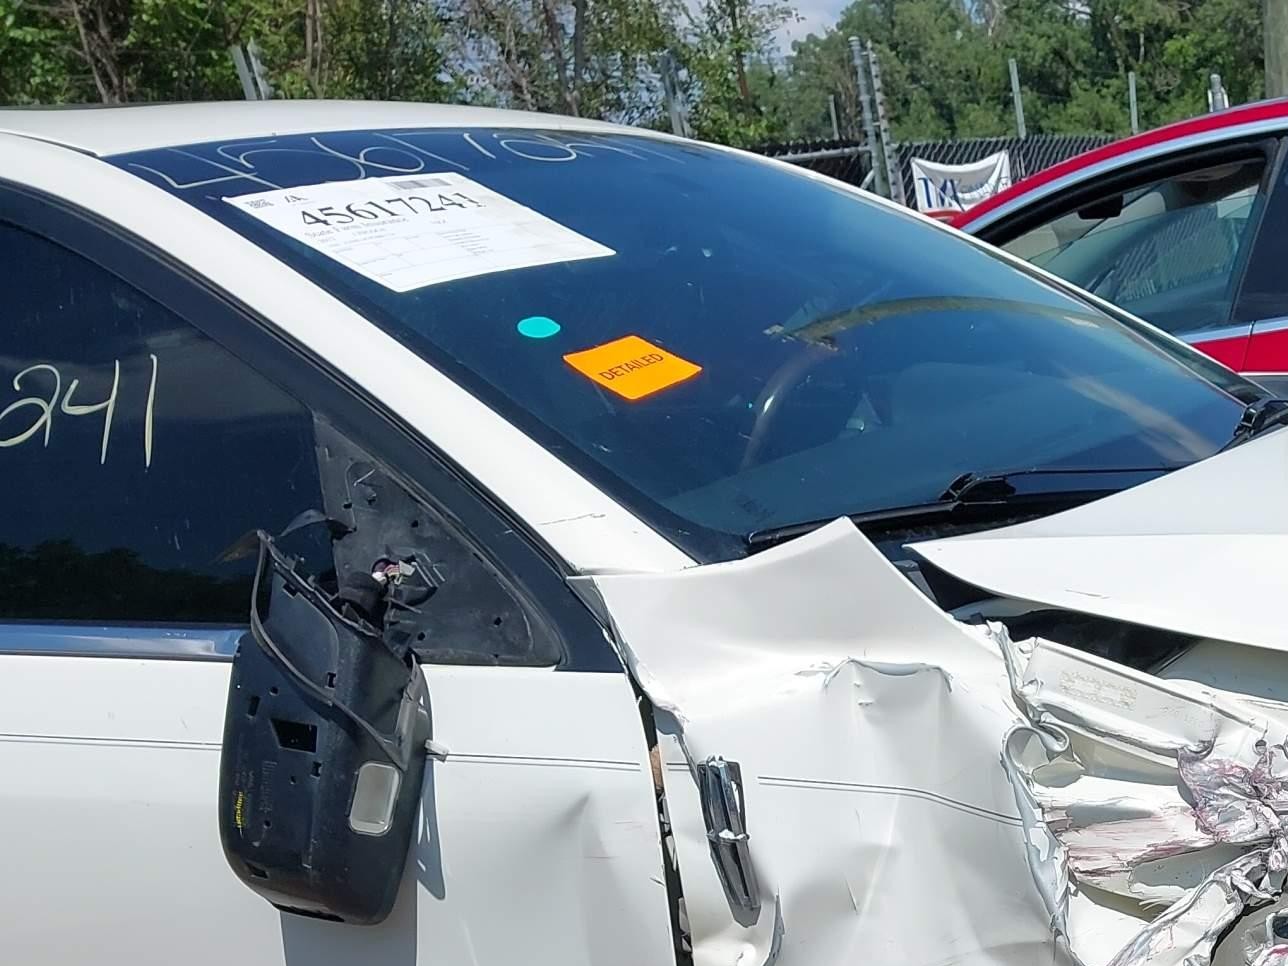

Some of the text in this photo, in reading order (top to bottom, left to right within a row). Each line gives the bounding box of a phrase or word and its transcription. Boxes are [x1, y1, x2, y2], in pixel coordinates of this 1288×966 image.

[301, 192, 487, 226] 45617241
[599, 352, 664, 381] DETAILED
[0, 353, 158, 468] 241
